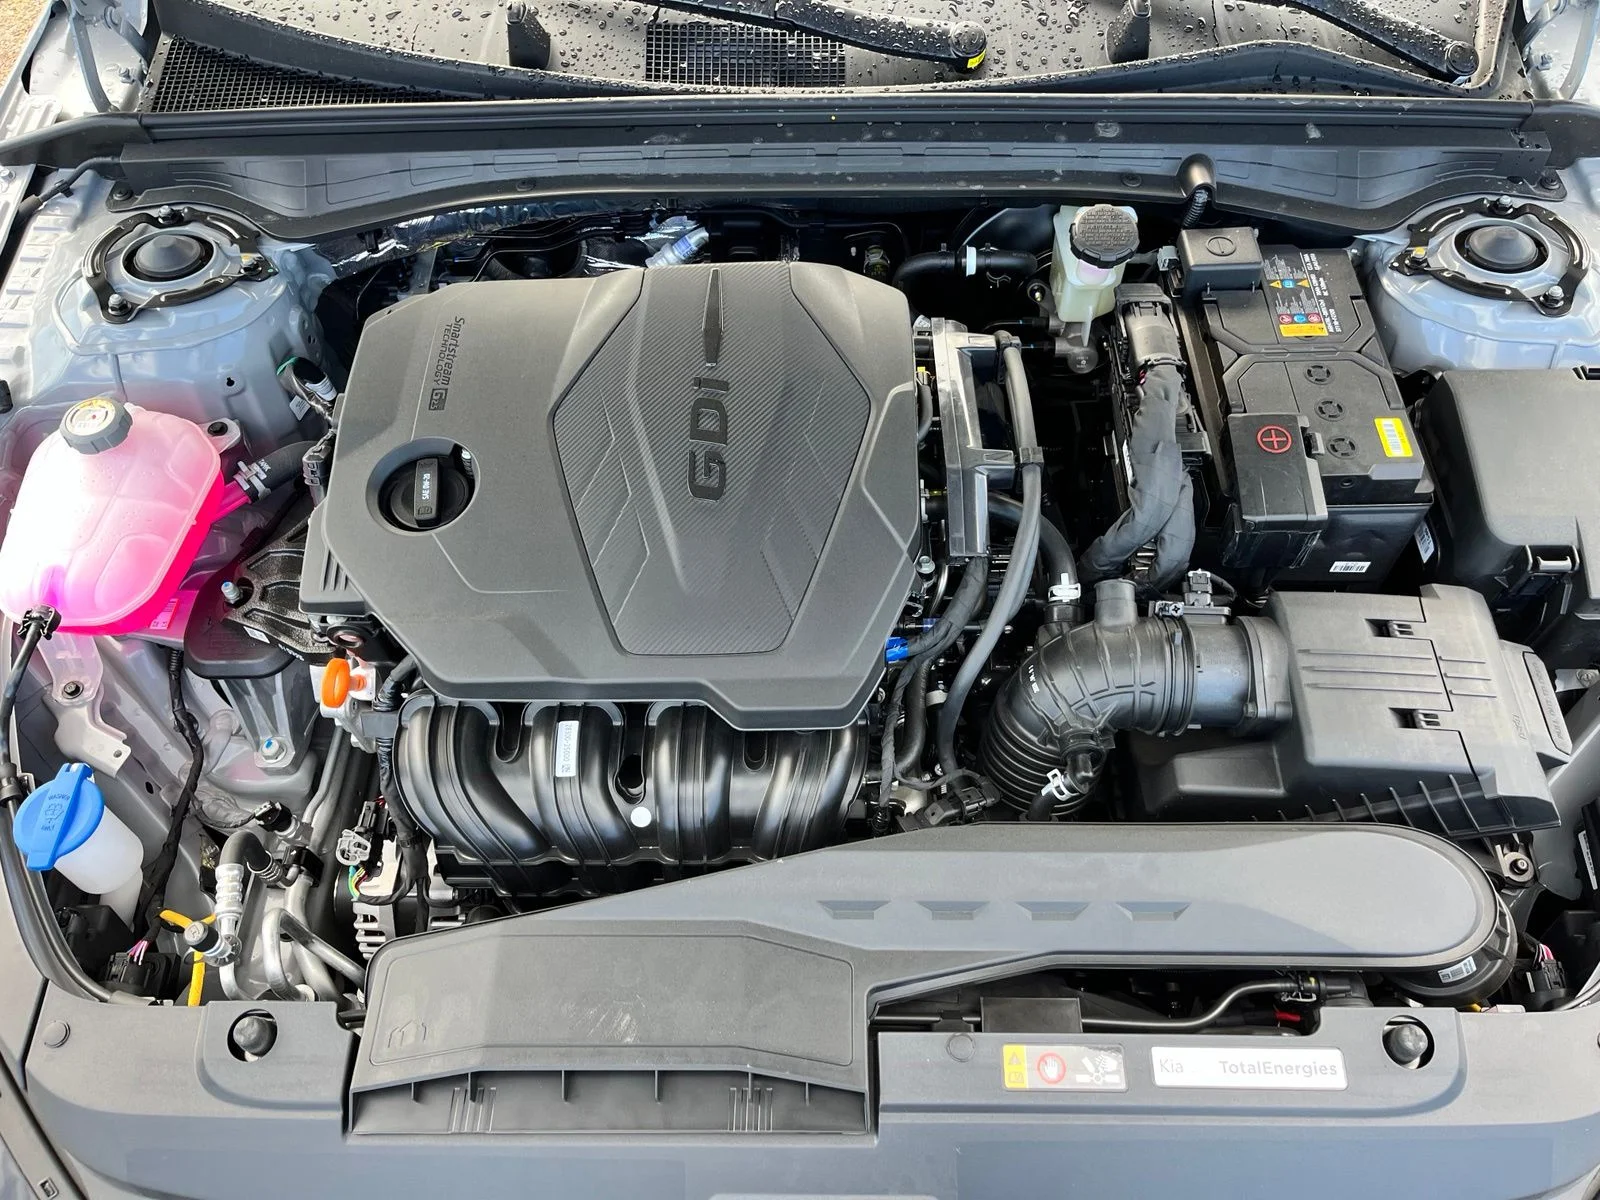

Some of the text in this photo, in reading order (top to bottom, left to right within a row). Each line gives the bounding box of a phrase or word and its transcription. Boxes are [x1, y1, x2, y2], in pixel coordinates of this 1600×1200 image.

[433, 322, 452, 386] TECHNOLOGY
[441, 316, 465, 386] Smartstream
[687, 376, 729, 501] GDI
[422, 489, 431, 500] SAE
[1159, 1058, 1338, 1078] Kia TotalEnergies
